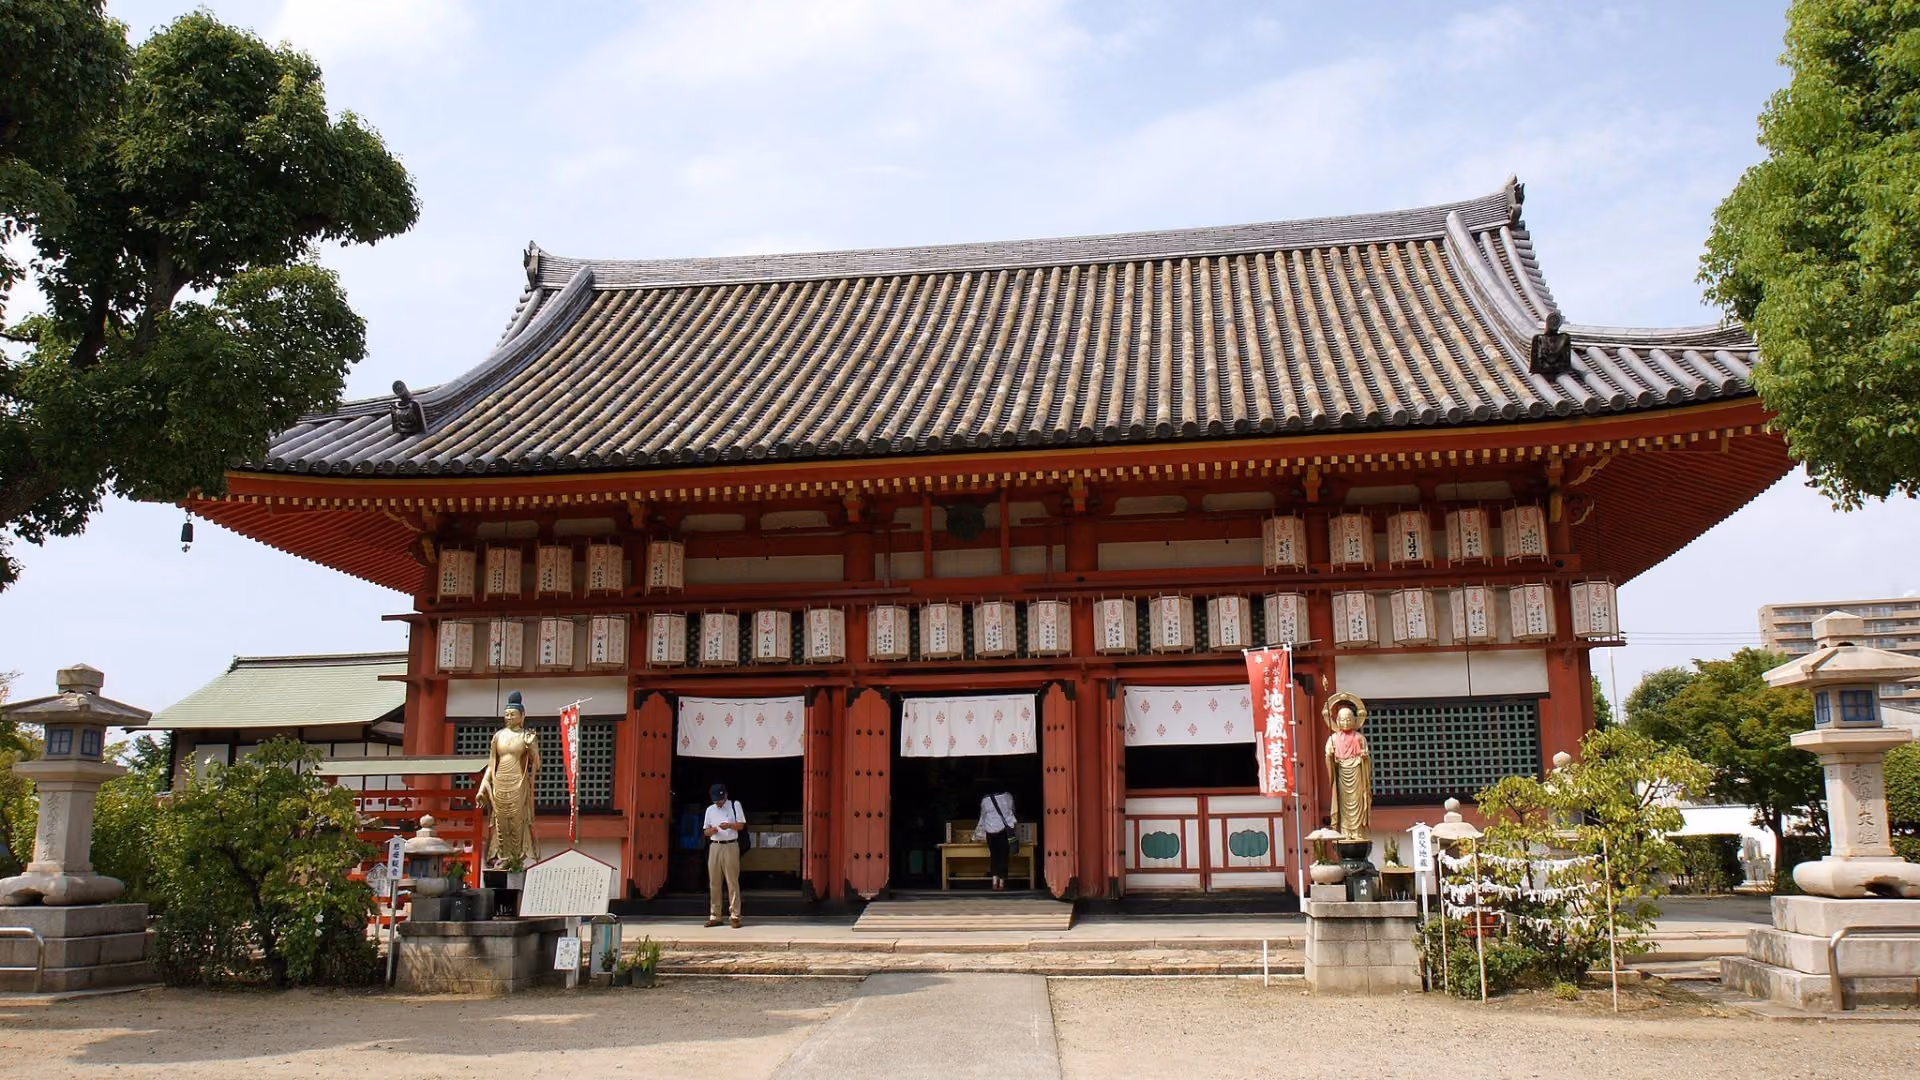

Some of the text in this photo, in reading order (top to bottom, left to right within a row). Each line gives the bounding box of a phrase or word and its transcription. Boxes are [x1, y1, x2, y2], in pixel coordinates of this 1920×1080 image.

[1407, 531, 1418, 559] モリサワ
[1264, 688, 1288, 793] 地蔵菩薩
